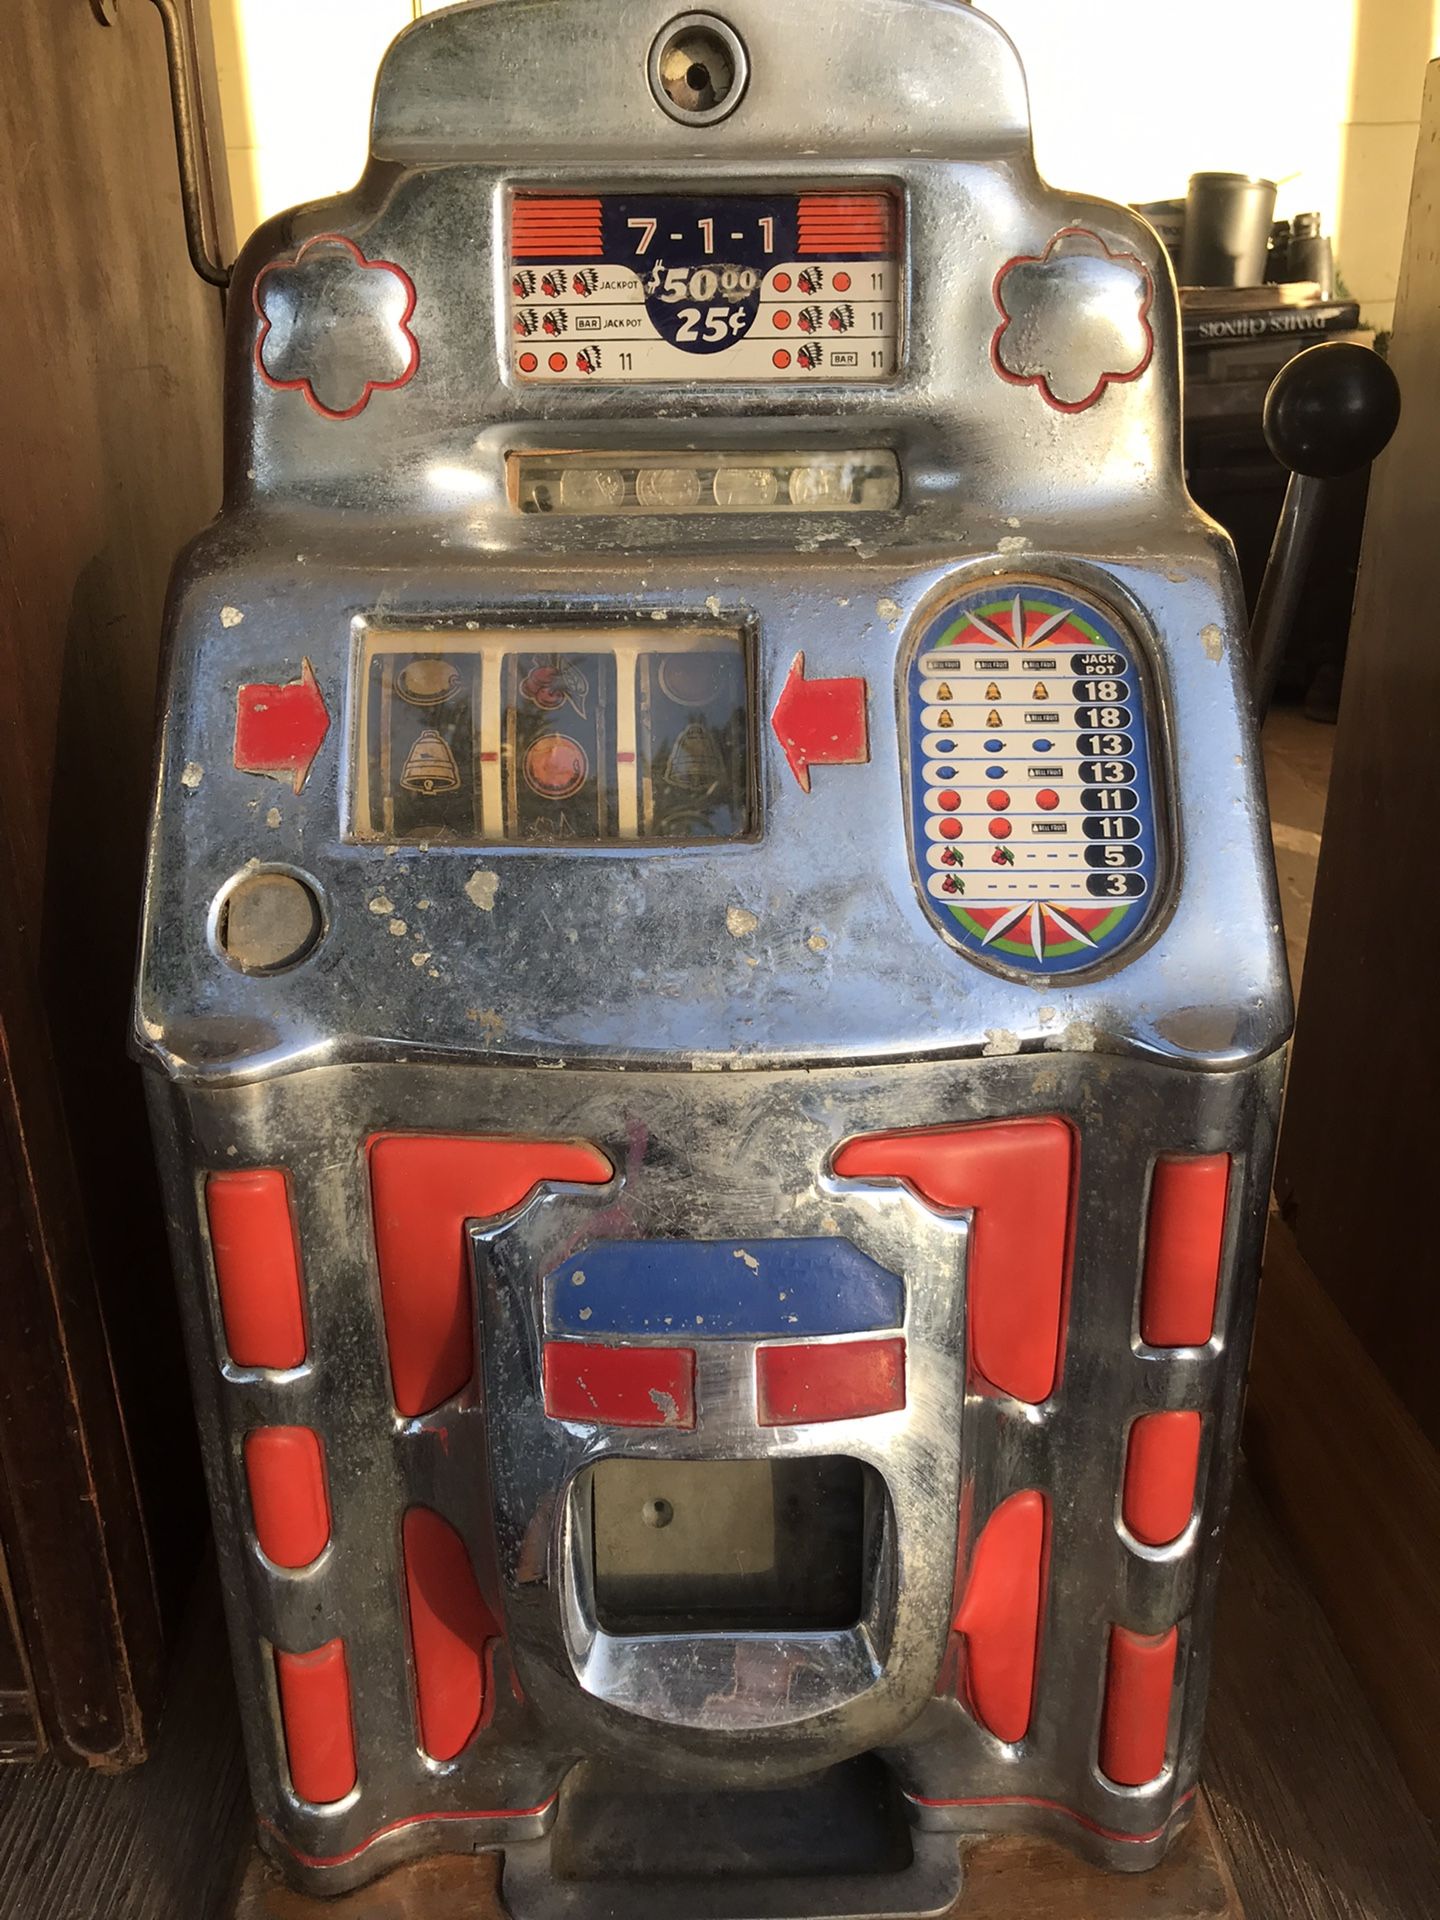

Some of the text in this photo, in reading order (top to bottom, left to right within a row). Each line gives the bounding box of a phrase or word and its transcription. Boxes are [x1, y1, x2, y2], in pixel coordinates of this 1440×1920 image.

[600, 281, 638, 290] JACKPOT
[870, 273, 883, 290] 11
[579, 320, 598, 328] BAR
[870, 312, 883, 330] 11
[619, 353, 632, 370] 11
[834, 355, 854, 363] BAR
[870, 351, 883, 368] 11
[1081, 654, 1117, 664] JACK
[1085, 665, 1115, 674] POT
[1085, 681, 1118, 701] 18
[1087, 707, 1120, 728] 18
[1089, 734, 1122, 755] 13
[1091, 762, 1124, 782] 13
[1097, 789, 1121, 809] 11
[1099, 817, 1124, 837] 11
[1104, 846, 1125, 866] 5
[1106, 874, 1127, 895] 3
